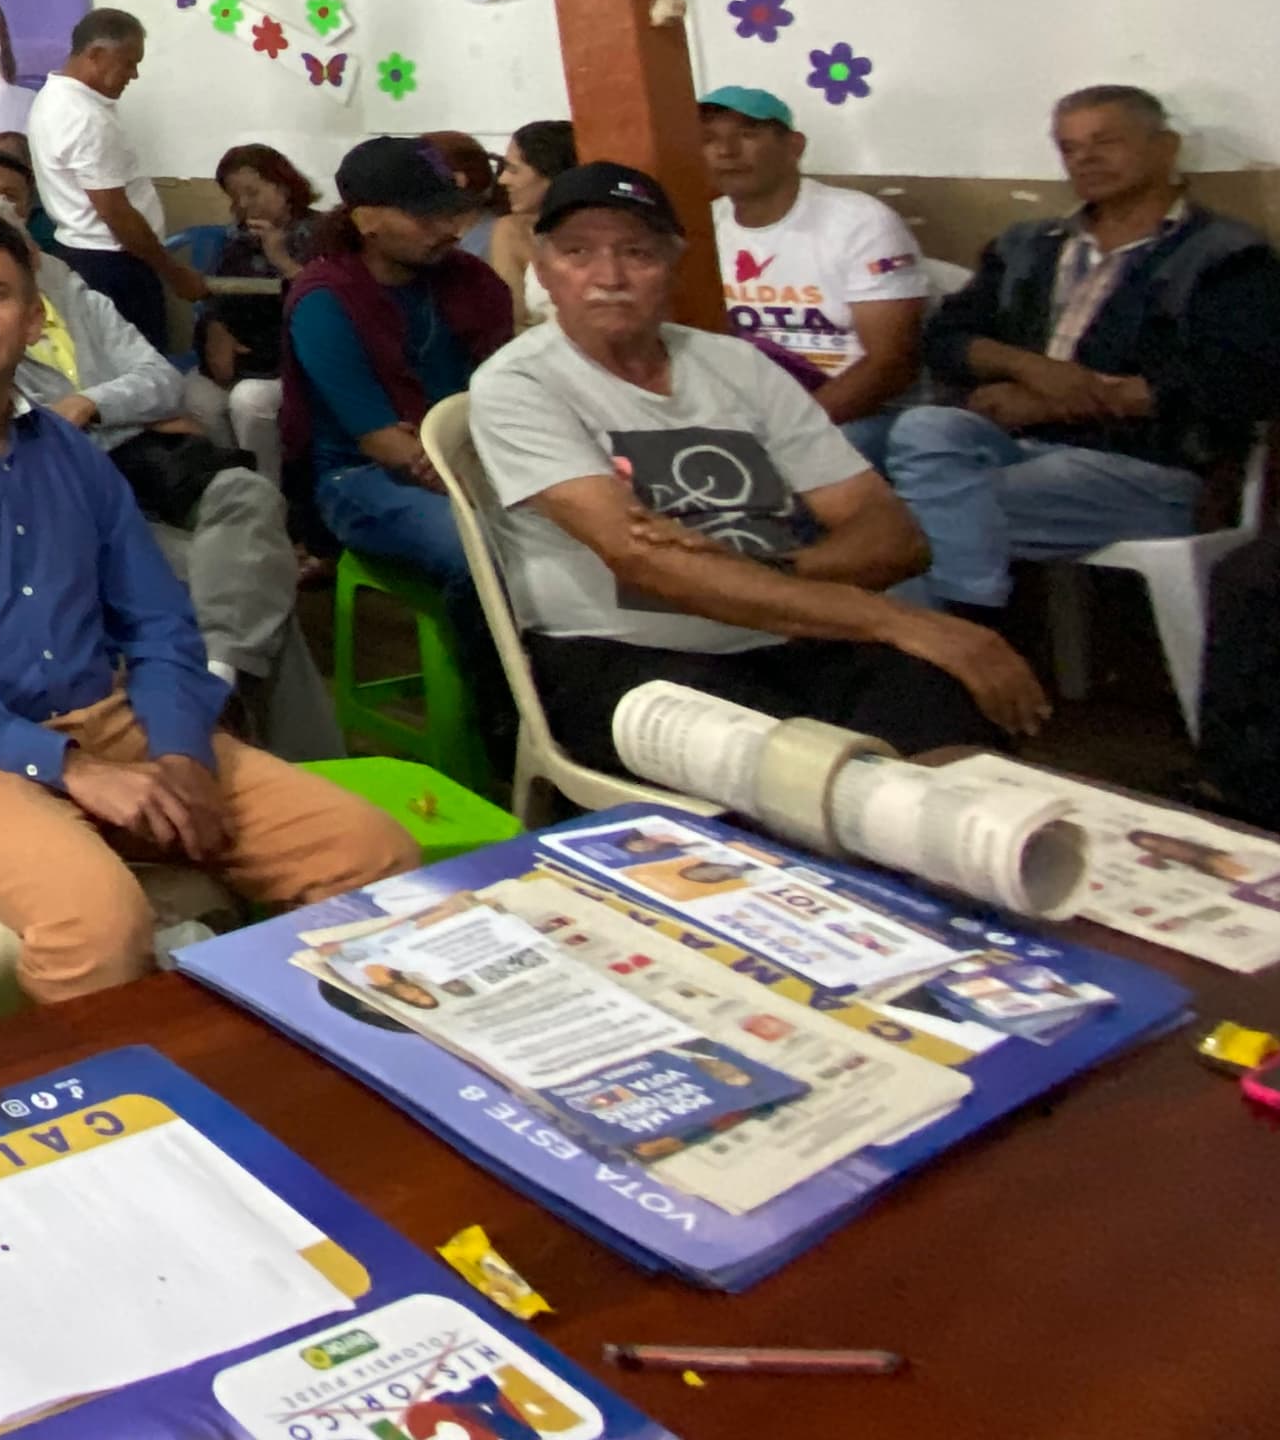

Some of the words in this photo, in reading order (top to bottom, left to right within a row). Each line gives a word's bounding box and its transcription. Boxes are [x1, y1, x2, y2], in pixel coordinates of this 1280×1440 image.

[573, 885, 913, 1043] CAMA
[458, 1085, 488, 1102] 8
[483, 1101, 583, 1160] ESTE
[594, 1162, 697, 1231] VOTA
